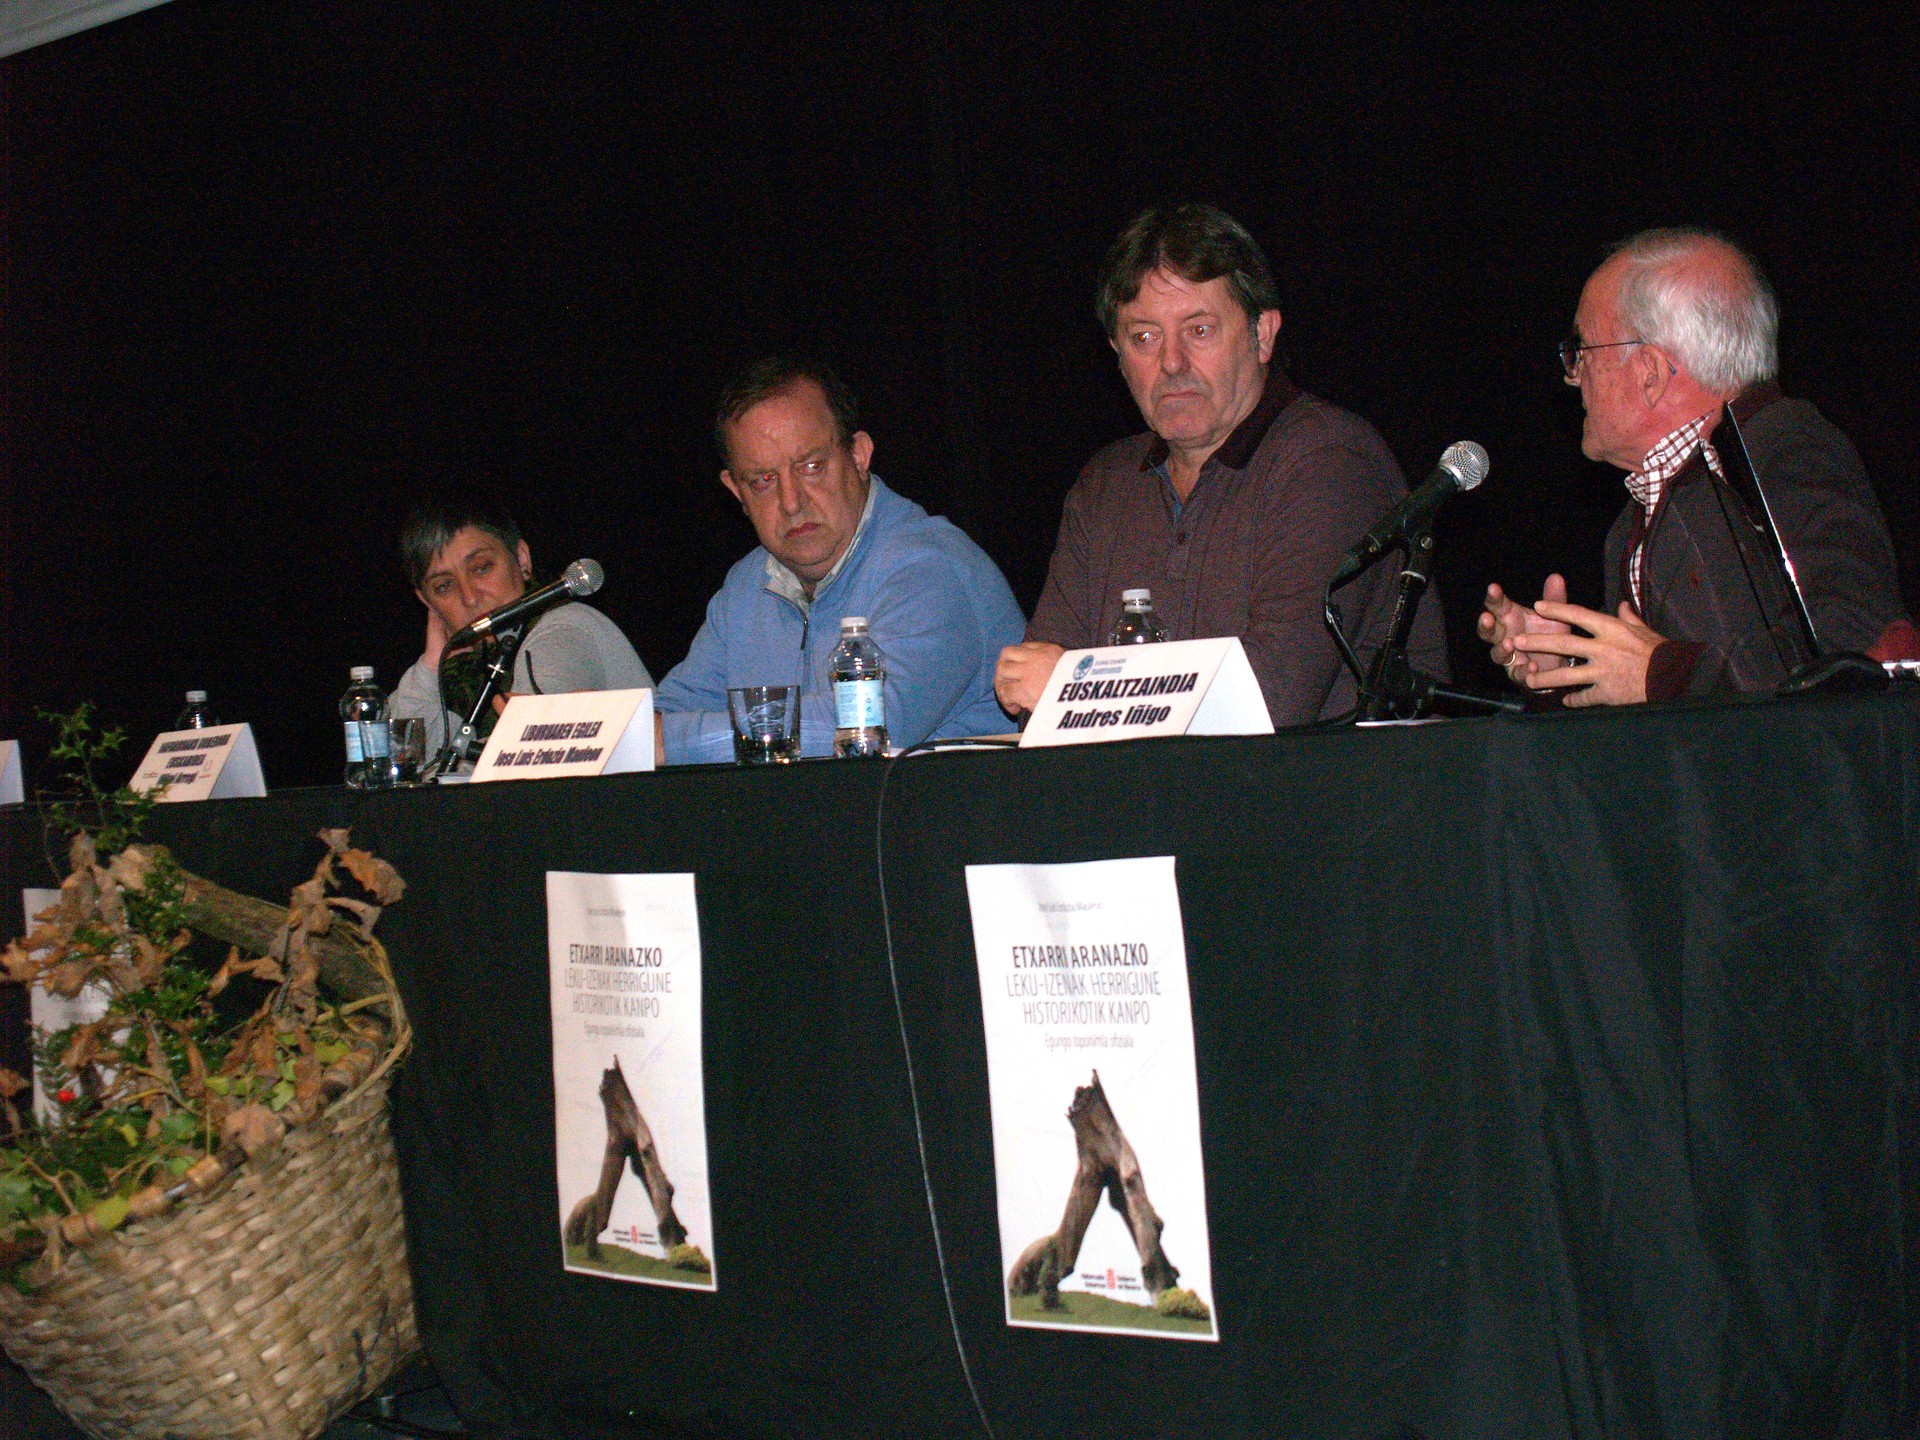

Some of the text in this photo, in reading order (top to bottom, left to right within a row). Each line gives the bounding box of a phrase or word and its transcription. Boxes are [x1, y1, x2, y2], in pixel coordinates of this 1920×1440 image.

[1057, 672, 1199, 702] EUSKALTZAINDIA
[1056, 704, 1171, 730] Andres Iñigo
[570, 944, 663, 968] ETXARRI ARANAZKO
[1012, 943, 1149, 969] ETXARRI ARANAZKO
[613, 971, 672, 993] HERRIGUNE
[1006, 971, 1162, 997] LEKU-IZENAK HERRIGUNE
[623, 997, 660, 1018] KANPO
[1023, 1000, 1150, 1025] HISTORIKOTIK KANPO
